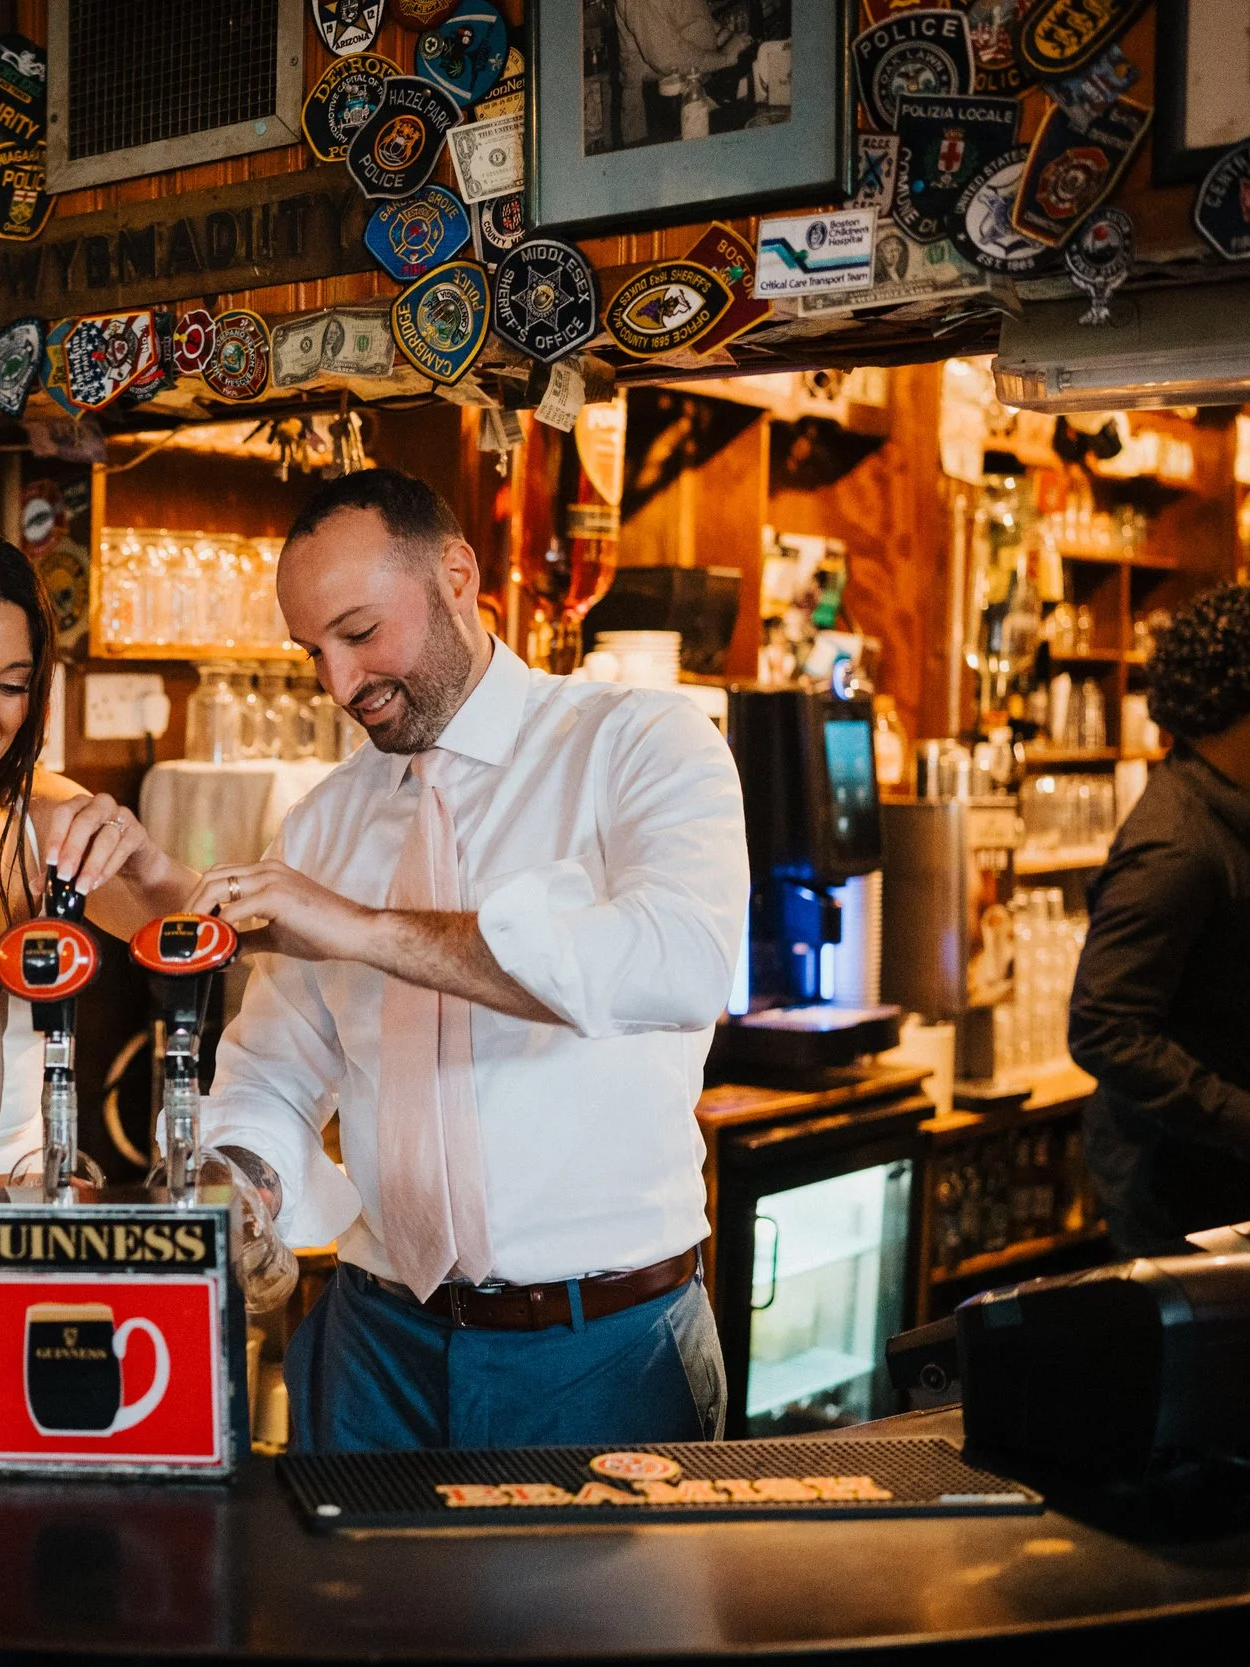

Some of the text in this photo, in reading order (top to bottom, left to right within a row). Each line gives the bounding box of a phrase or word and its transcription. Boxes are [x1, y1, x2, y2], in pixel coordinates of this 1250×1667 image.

[335, 32, 371, 50] ARIZONA
[859, 19, 960, 59] POLICE
[881, 51, 943, 84] OAK LAWN
[339, 75, 367, 92] CAPITAL
[368, 76, 377, 85] OF
[388, 89, 451, 133] HAZEL PARK
[902, 104, 1013, 123] POLIZIA LOCALE
[3, 171, 46, 191] POLIC
[358, 153, 406, 187] POLICE
[897, 147, 920, 224] COMUNE
[427, 191, 459, 219] GROVE
[955, 174, 986, 215] UNITED
[483, 222, 507, 246] COUNTY
[829, 219, 860, 230] Boston
[828, 235, 864, 247] Hospital
[453, 267, 485, 312] POLICE
[520, 247, 590, 304] MIDDLESEX
[760, 273, 868, 291] Critical Care Transport Team
[497, 268, 584, 349] SHERIFF'S OFFICE
[619, 279, 649, 348] DUKES COUNTY
[398, 302, 453, 376] CAMBRIDGE
[672, 310, 711, 340] OFFICE
[35, 1348, 108, 1360] GUINNESS
